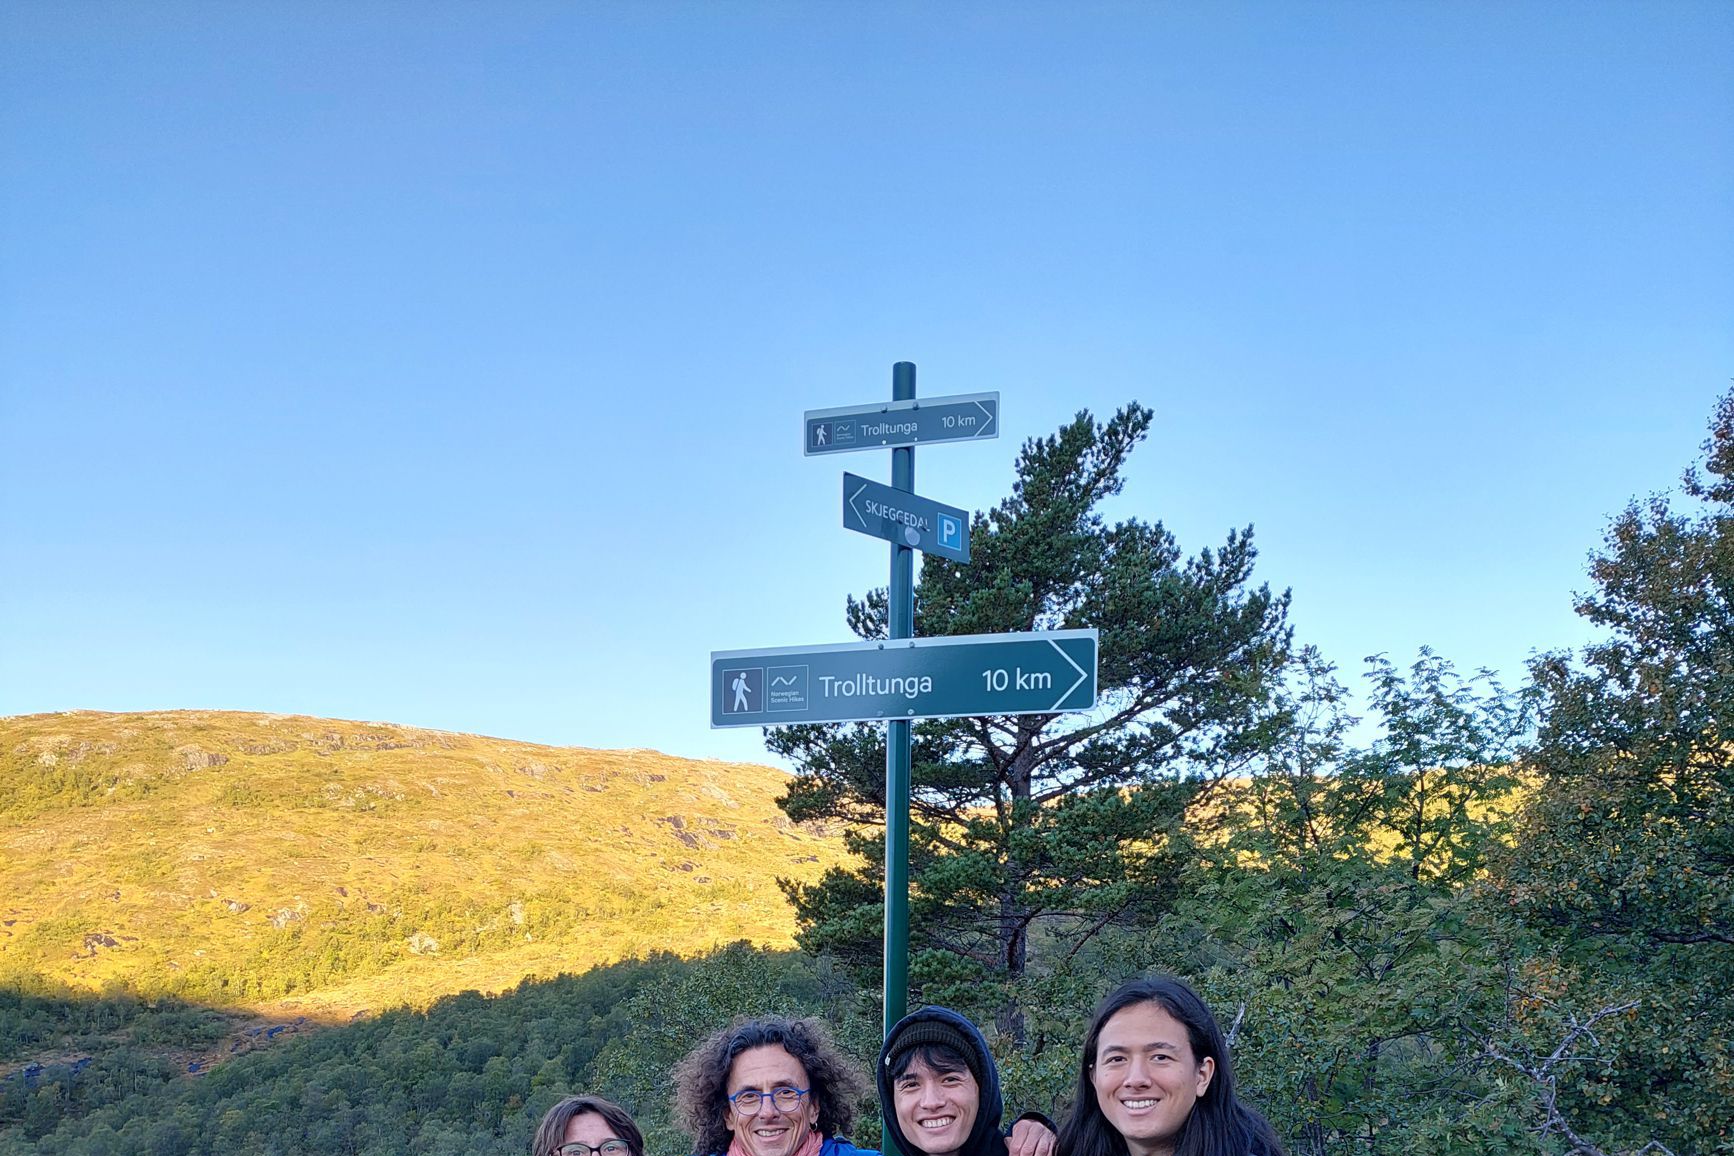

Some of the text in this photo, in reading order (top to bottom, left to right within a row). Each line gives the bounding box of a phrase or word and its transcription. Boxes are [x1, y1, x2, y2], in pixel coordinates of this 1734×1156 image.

[861, 421, 918, 437] Trolltunga
[941, 415, 955, 429] 10
[958, 415, 976, 427] km
[865, 500, 956, 543] SKJEGGEDAL P
[818, 667, 1051, 699] Trolltunga 10 km
